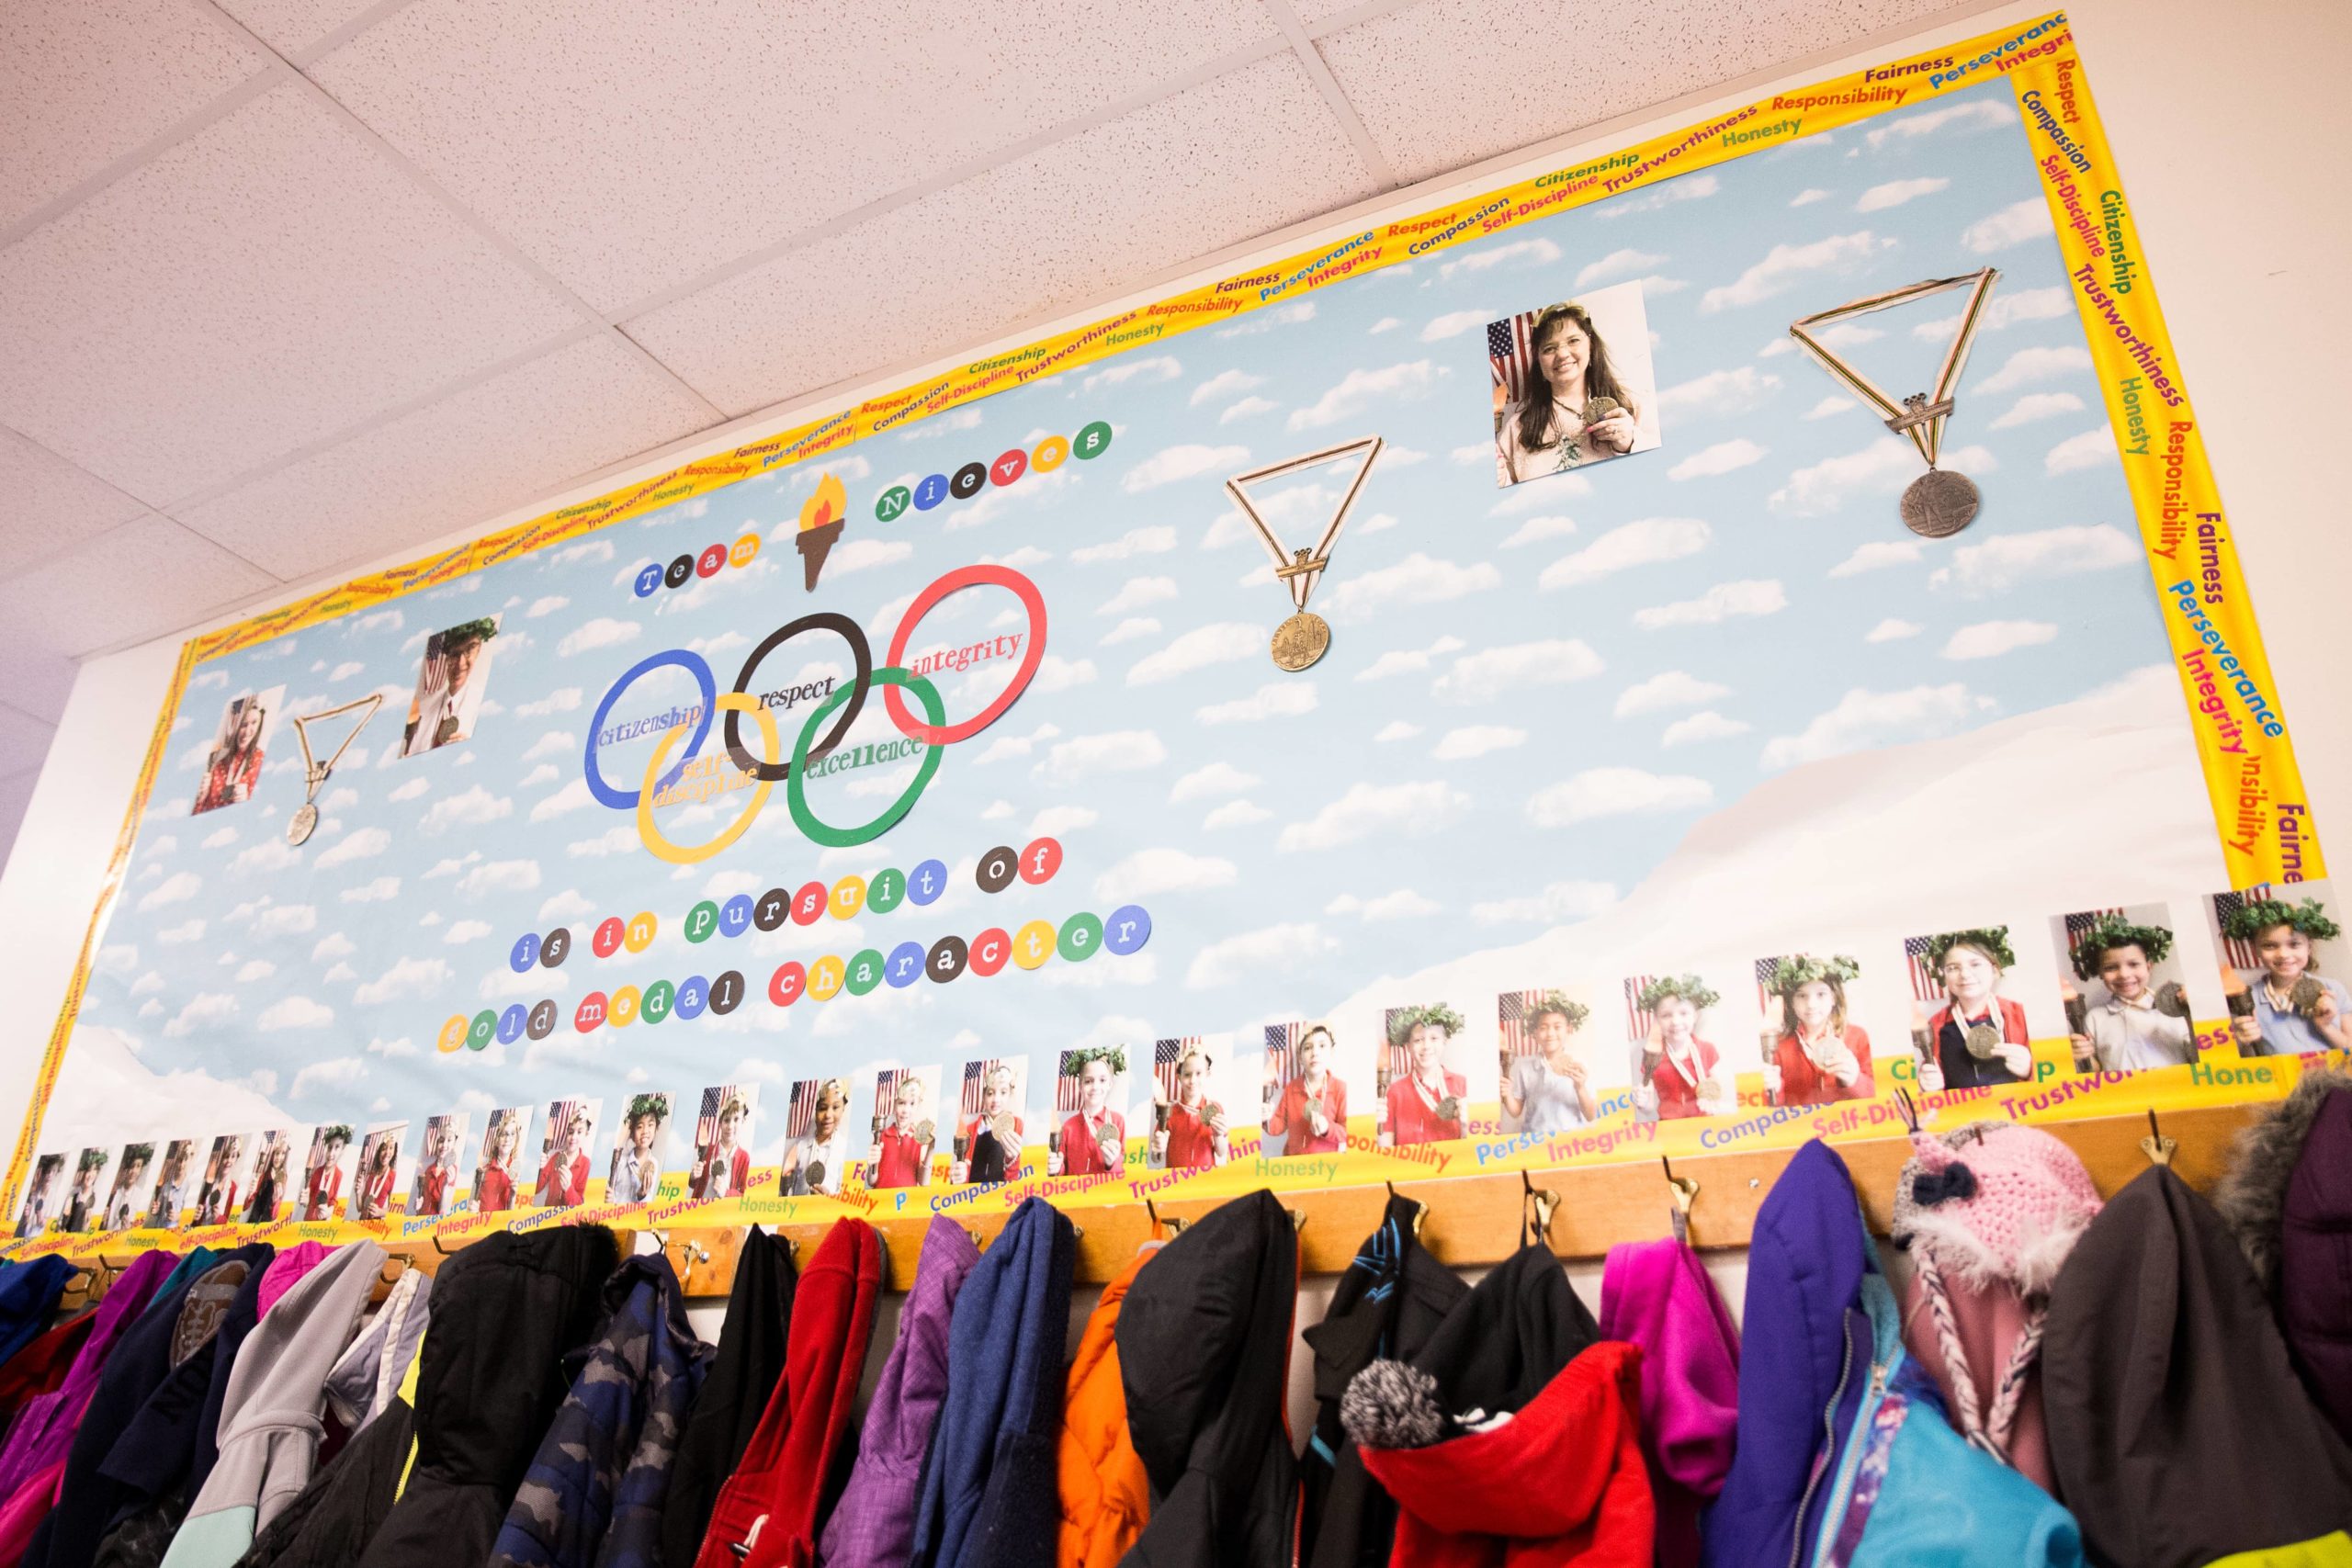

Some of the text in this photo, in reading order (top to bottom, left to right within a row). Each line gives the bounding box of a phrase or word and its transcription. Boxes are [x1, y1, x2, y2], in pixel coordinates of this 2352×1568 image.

[1864, 54, 1954, 84] Fairness
[1929, 13, 2068, 90] Perseveranc
[1996, 28, 2074, 73] Integri
[1771, 86, 1909, 111] Responsibility
[2057, 59, 2081, 125] Respect
[1602, 105, 1758, 195] Trustworthiness
[1722, 118, 1803, 149] Honesty
[2021, 90, 2092, 174] Compassion
[1534, 152, 1641, 188] Citizenship
[1386, 212, 1458, 238] Respect
[1408, 197, 1511, 256] Compassion
[1482, 175, 1600, 233] Self-Discipline
[2041, 154, 2105, 258] Self-Discipline
[2100, 190, 2138, 295] Citizenship
[1215, 271, 1282, 295] Fairness
[1259, 230, 1375, 302] Perseverance
[1307, 245, 1384, 288] Integrity
[1146, 297, 1245, 318] Responsibility
[1015, 310, 1137, 383] Trustworthiness
[1105, 321, 1165, 346] Honesty
[2073, 263, 2185, 408] Trustworthiness
[968, 346, 1046, 375] Citizenship
[860, 393, 912, 414] Respect
[872, 381, 949, 432] Compassion
[926, 365, 1015, 414] Self-Discipline
[2120, 376, 2152, 456] Honesty
[733, 441, 781, 459] Fairness
[763, 410, 852, 468] Perseverance
[797, 423, 854, 459] Integrity
[587, 470, 678, 530] Trustworthiness
[639, 429, 1102, 592] Team Nieves
[652, 482, 695, 502] Honesty
[2153, 421, 2193, 561] Responsibility
[2196, 513, 2226, 604] Fairness
[909, 631, 1024, 680] integrity
[2167, 579, 2284, 739] Perseverance
[756, 675, 835, 712] respect
[2182, 649, 2249, 755] Integrity
[597, 704, 704, 748] citizenship
[805, 734, 924, 781] excellence
[652, 766, 758, 808] discipline
[2228, 755, 2268, 856] nsibility
[2277, 804, 2310, 884] Fairne
[691, 869, 935, 936] pursuit
[445, 917, 1137, 1046] gold medal character
[2190, 1063, 2273, 1087] Hone
[1346, 1134, 1453, 1174] ponsibility
[1547, 1120, 1657, 1163] Integrity
[1004, 1169, 1125, 1208] Self-Discipline
[1255, 1158, 1339, 1182] Honesty
[435, 1211, 492, 1237] Integrity
[739, 1196, 797, 1219] Honesty
[125, 1234, 160, 1248] Honesty
[179, 1225, 238, 1250] elf-Discipline
[298, 1224, 338, 1243] Honesty
